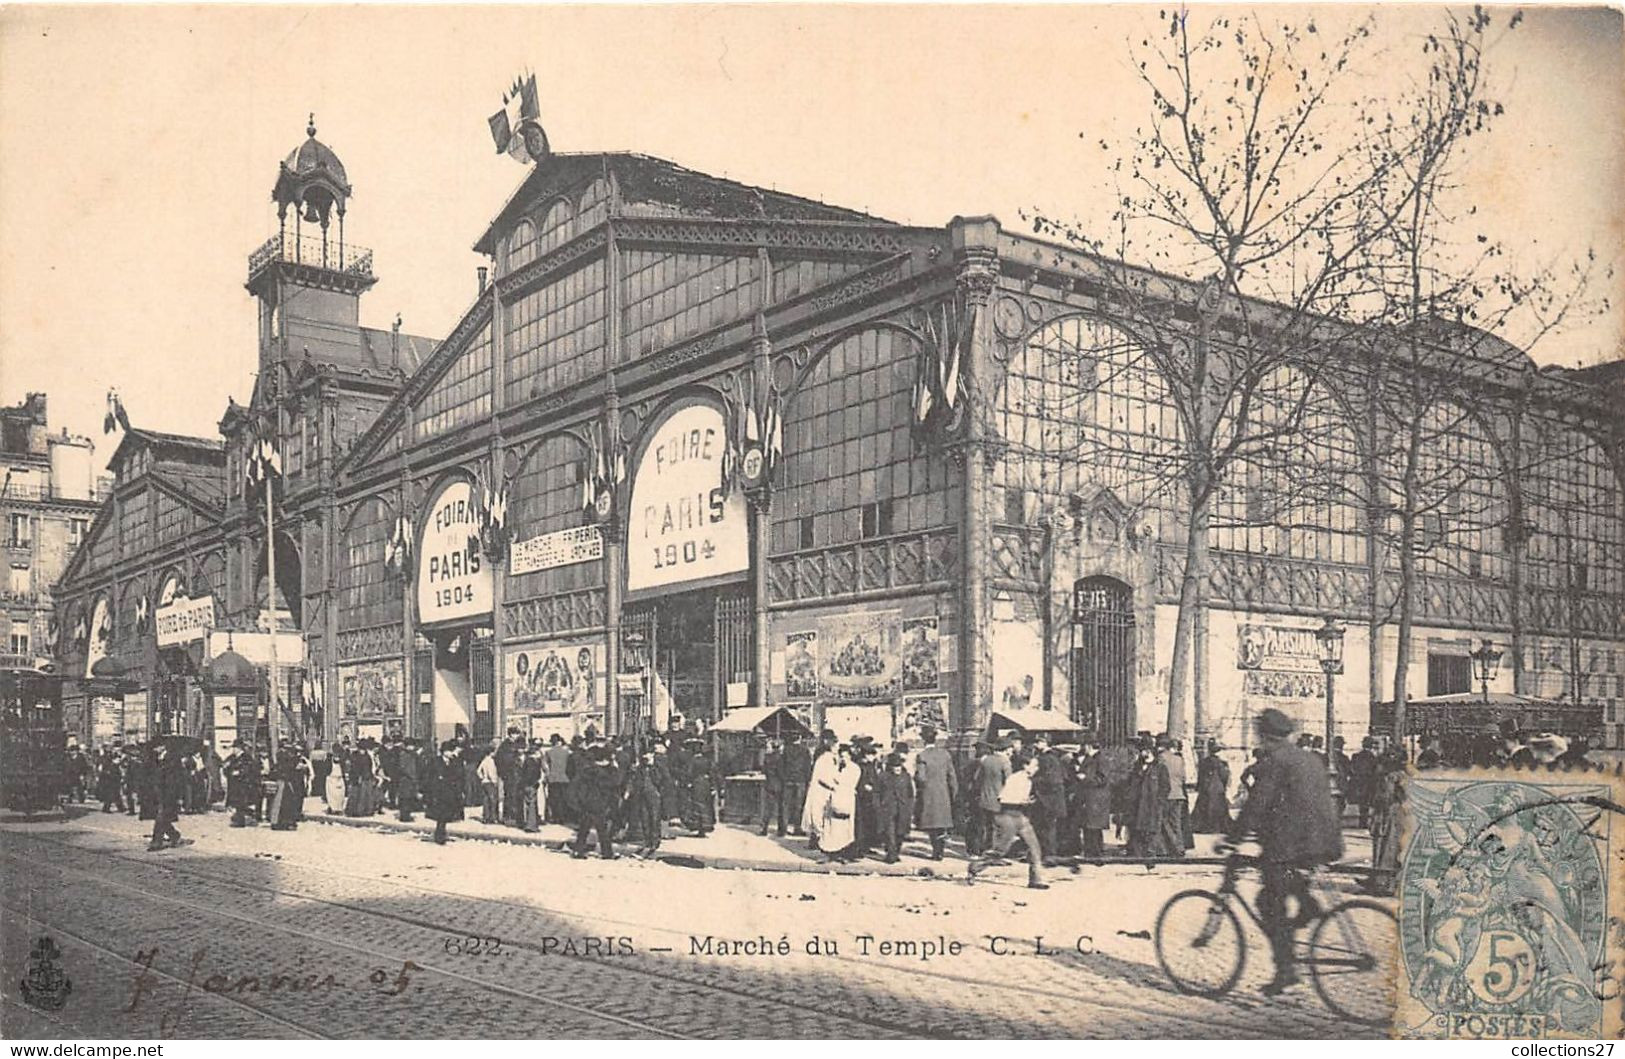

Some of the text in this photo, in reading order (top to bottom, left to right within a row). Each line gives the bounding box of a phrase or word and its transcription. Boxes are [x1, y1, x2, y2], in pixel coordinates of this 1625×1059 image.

[656, 428, 715, 475] FOIRE
[436, 500, 478, 534] FOIR
[645, 487, 725, 539] PARIS
[430, 549, 480, 583] PARIS
[654, 539, 716, 569] 1904
[436, 584, 474, 608] 1904
[1484, 934, 1518, 997] 5
[1452, 1014, 1545, 1038] POSTES
